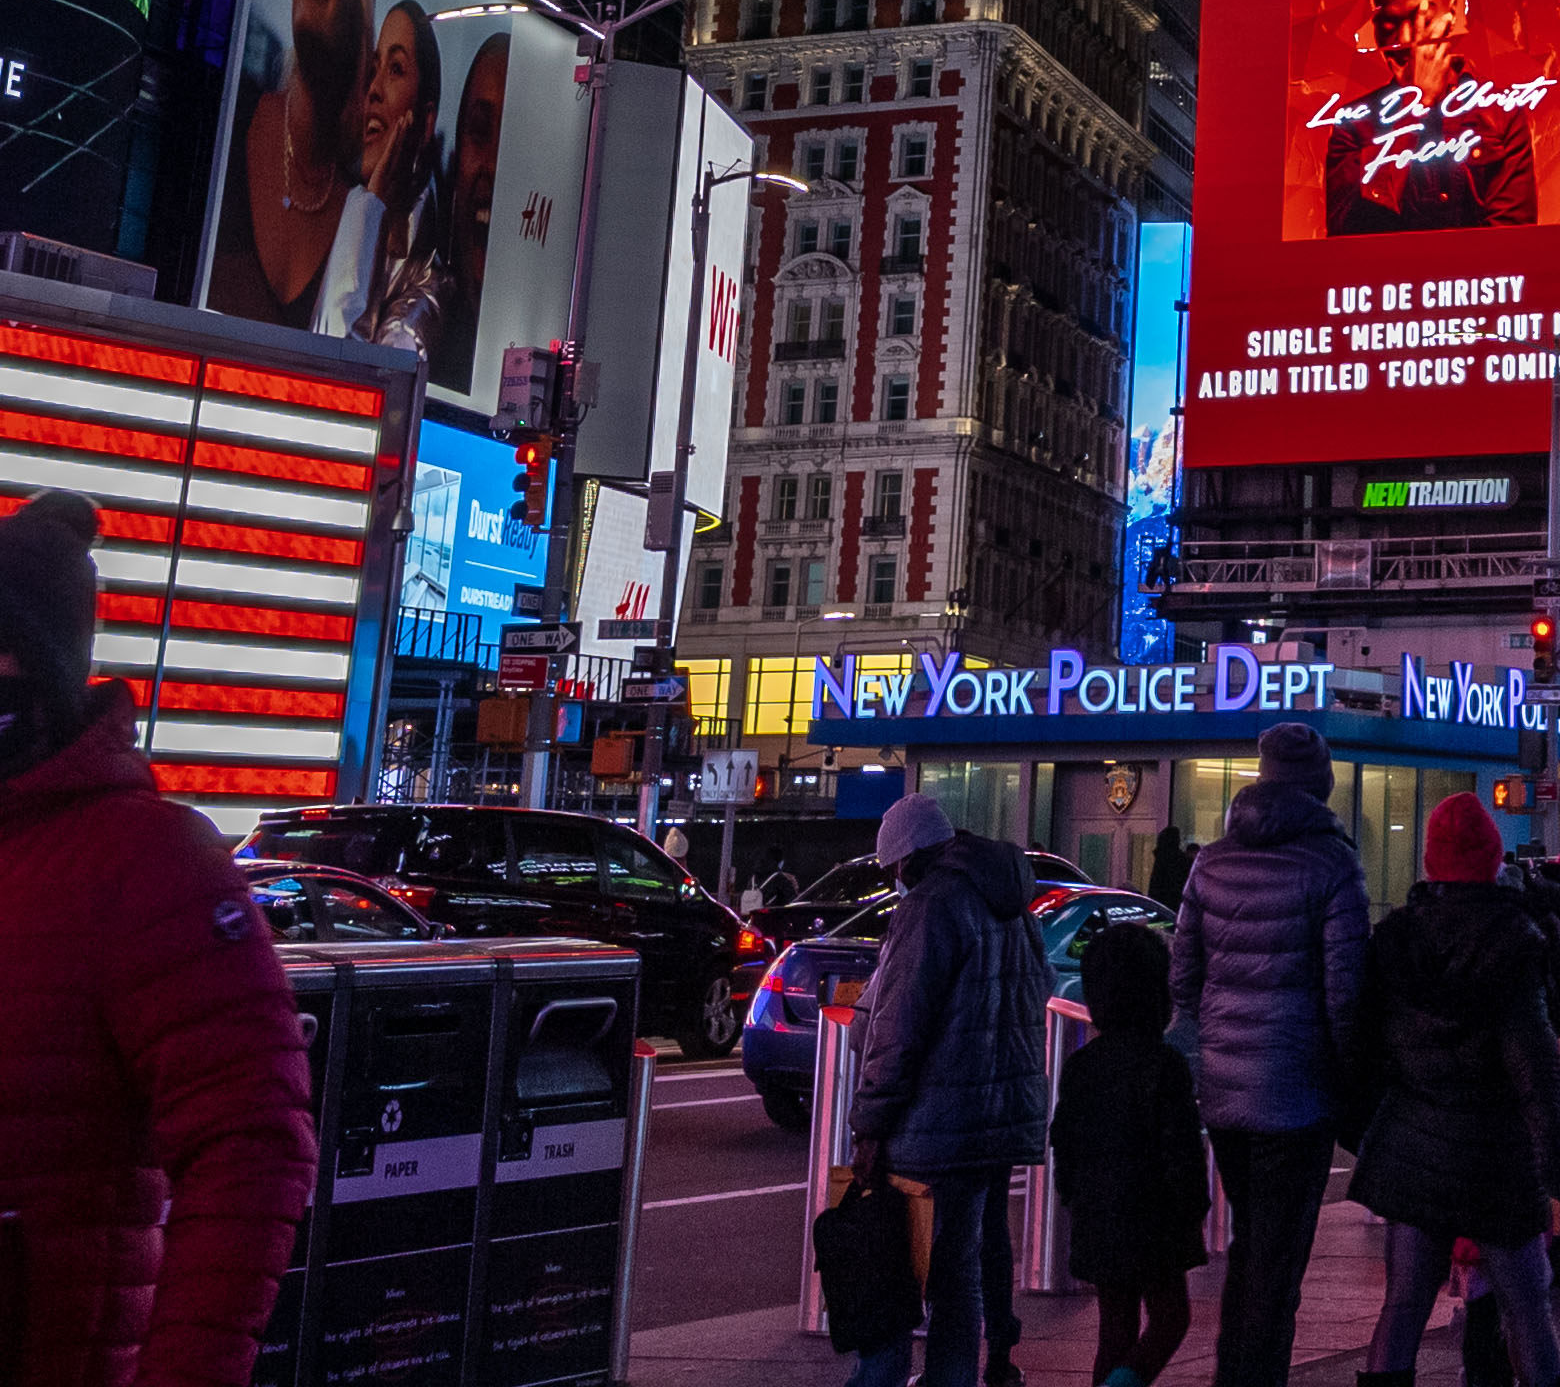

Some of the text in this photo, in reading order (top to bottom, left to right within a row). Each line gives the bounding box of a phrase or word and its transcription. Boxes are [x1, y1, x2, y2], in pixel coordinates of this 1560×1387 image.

[1305, 89, 1374, 132] Luc
[1438, 74, 1558, 115] Christy
[1361, 124, 1482, 184] Focus
[1326, 274, 1526, 317] LUC DE CHRISTY
[1246, 323, 1335, 358] SINGLE
[1496, 312, 1545, 344] OUT
[1197, 365, 1279, 401] ALBUM
[1288, 361, 1371, 395] TITLED
[511, 629, 570, 646] ONE WAY
[629, 686, 649, 696] ONE
[384, 1159, 420, 1179] PAPER
[544, 1143, 576, 1161] TRASH
